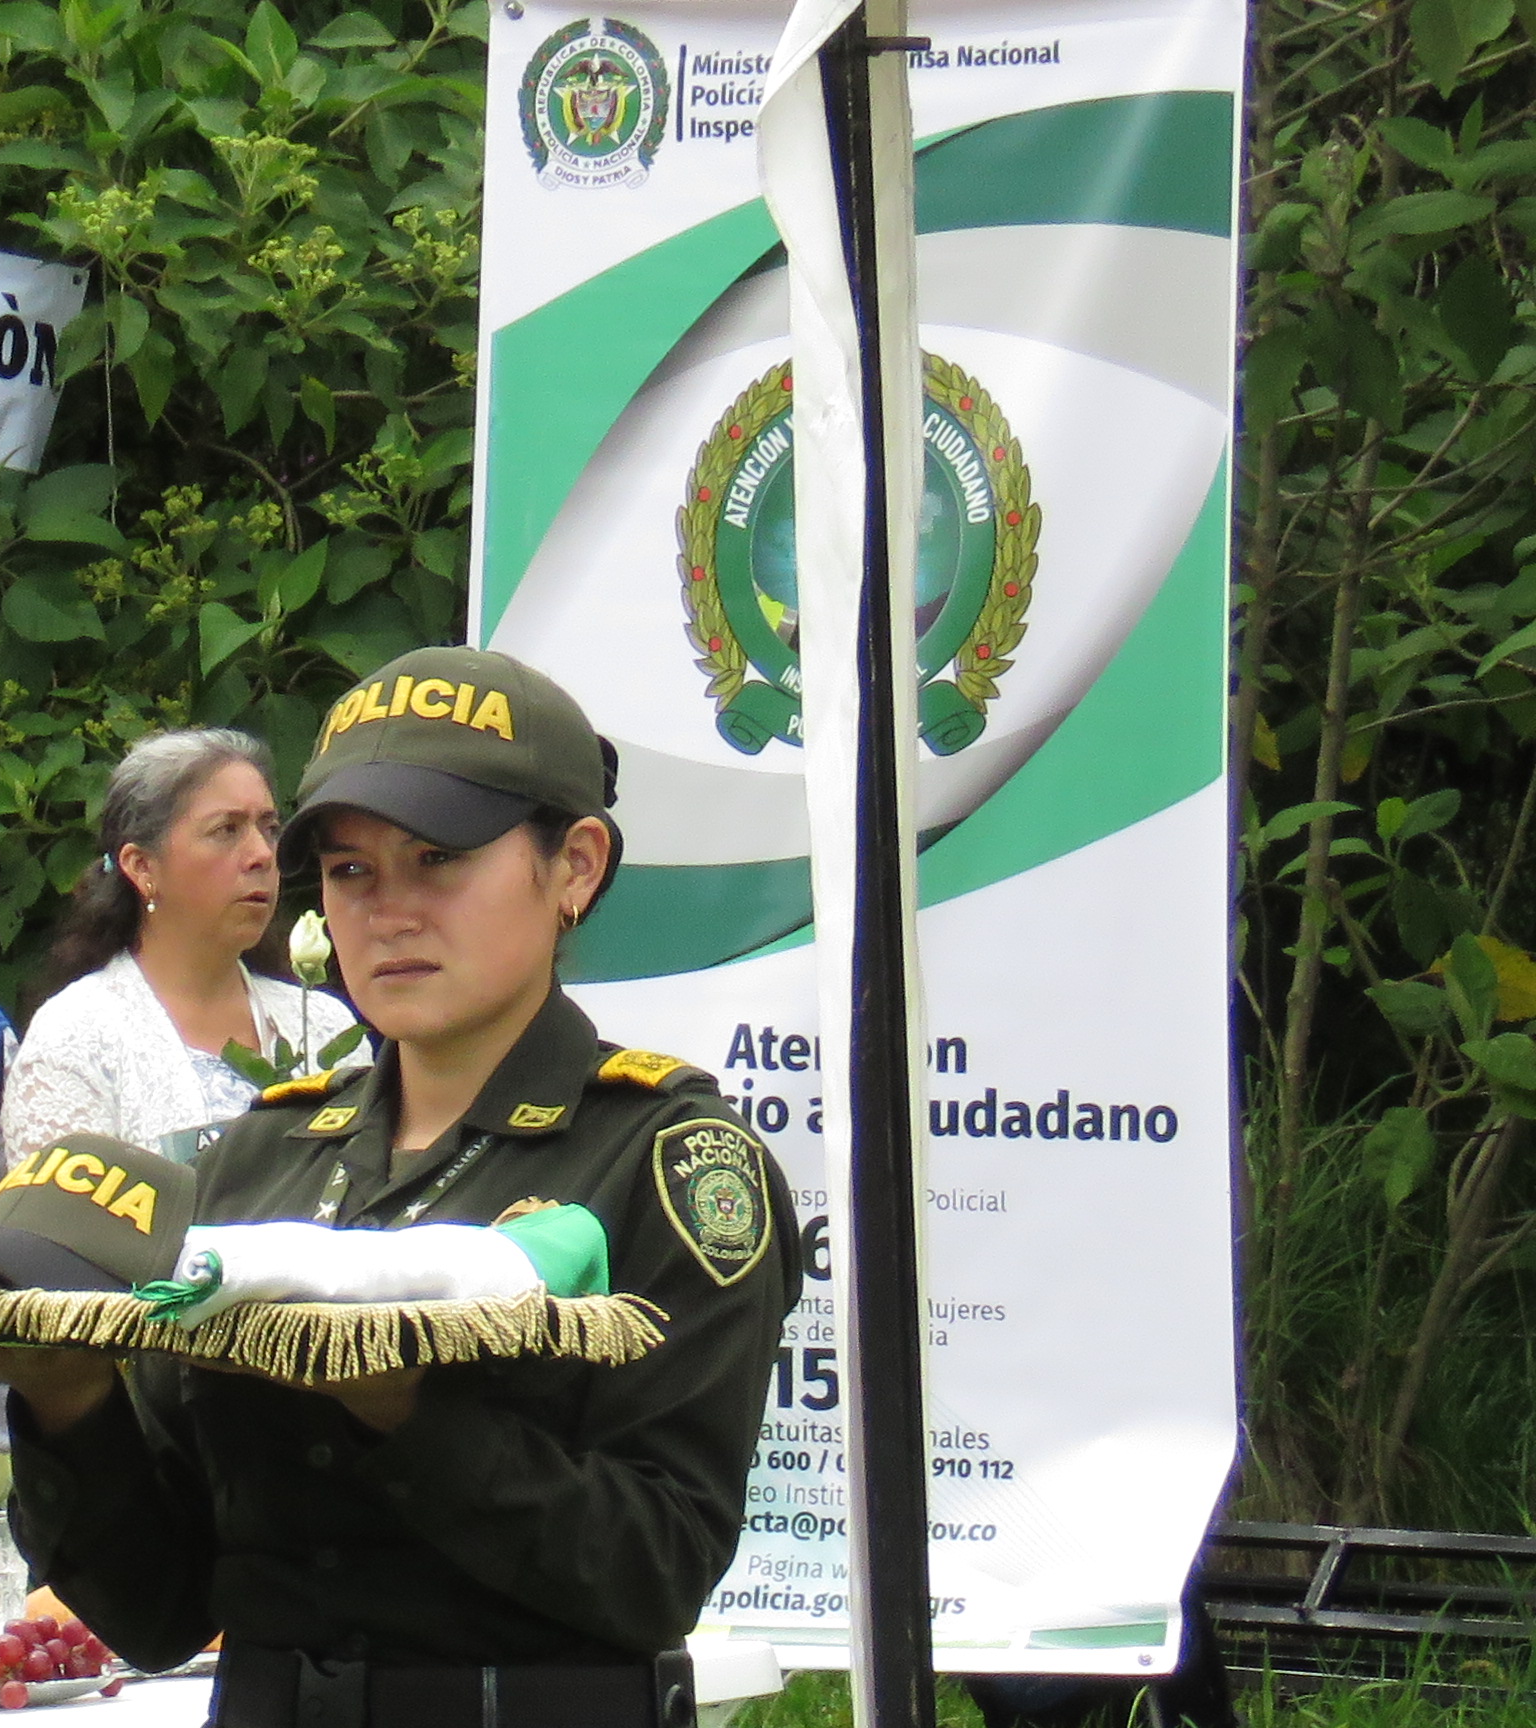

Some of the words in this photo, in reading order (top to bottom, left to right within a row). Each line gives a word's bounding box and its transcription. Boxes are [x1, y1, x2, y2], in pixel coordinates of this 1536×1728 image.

[589, 37, 606, 47] DE
[618, 43, 652, 112] COLOMBIA
[957, 39, 1060, 67] Nacional
[592, 126, 648, 168] NACIONAL
[723, 425, 790, 530] ATENCIÓN
[319, 675, 515, 756] POLICIA
[928, 1087, 1179, 1144] udadano
[767, 1450, 811, 1471] 600
[931, 1457, 972, 1479] 910
[979, 1459, 1015, 1480] 112
[747, 1552, 824, 1583] Página
